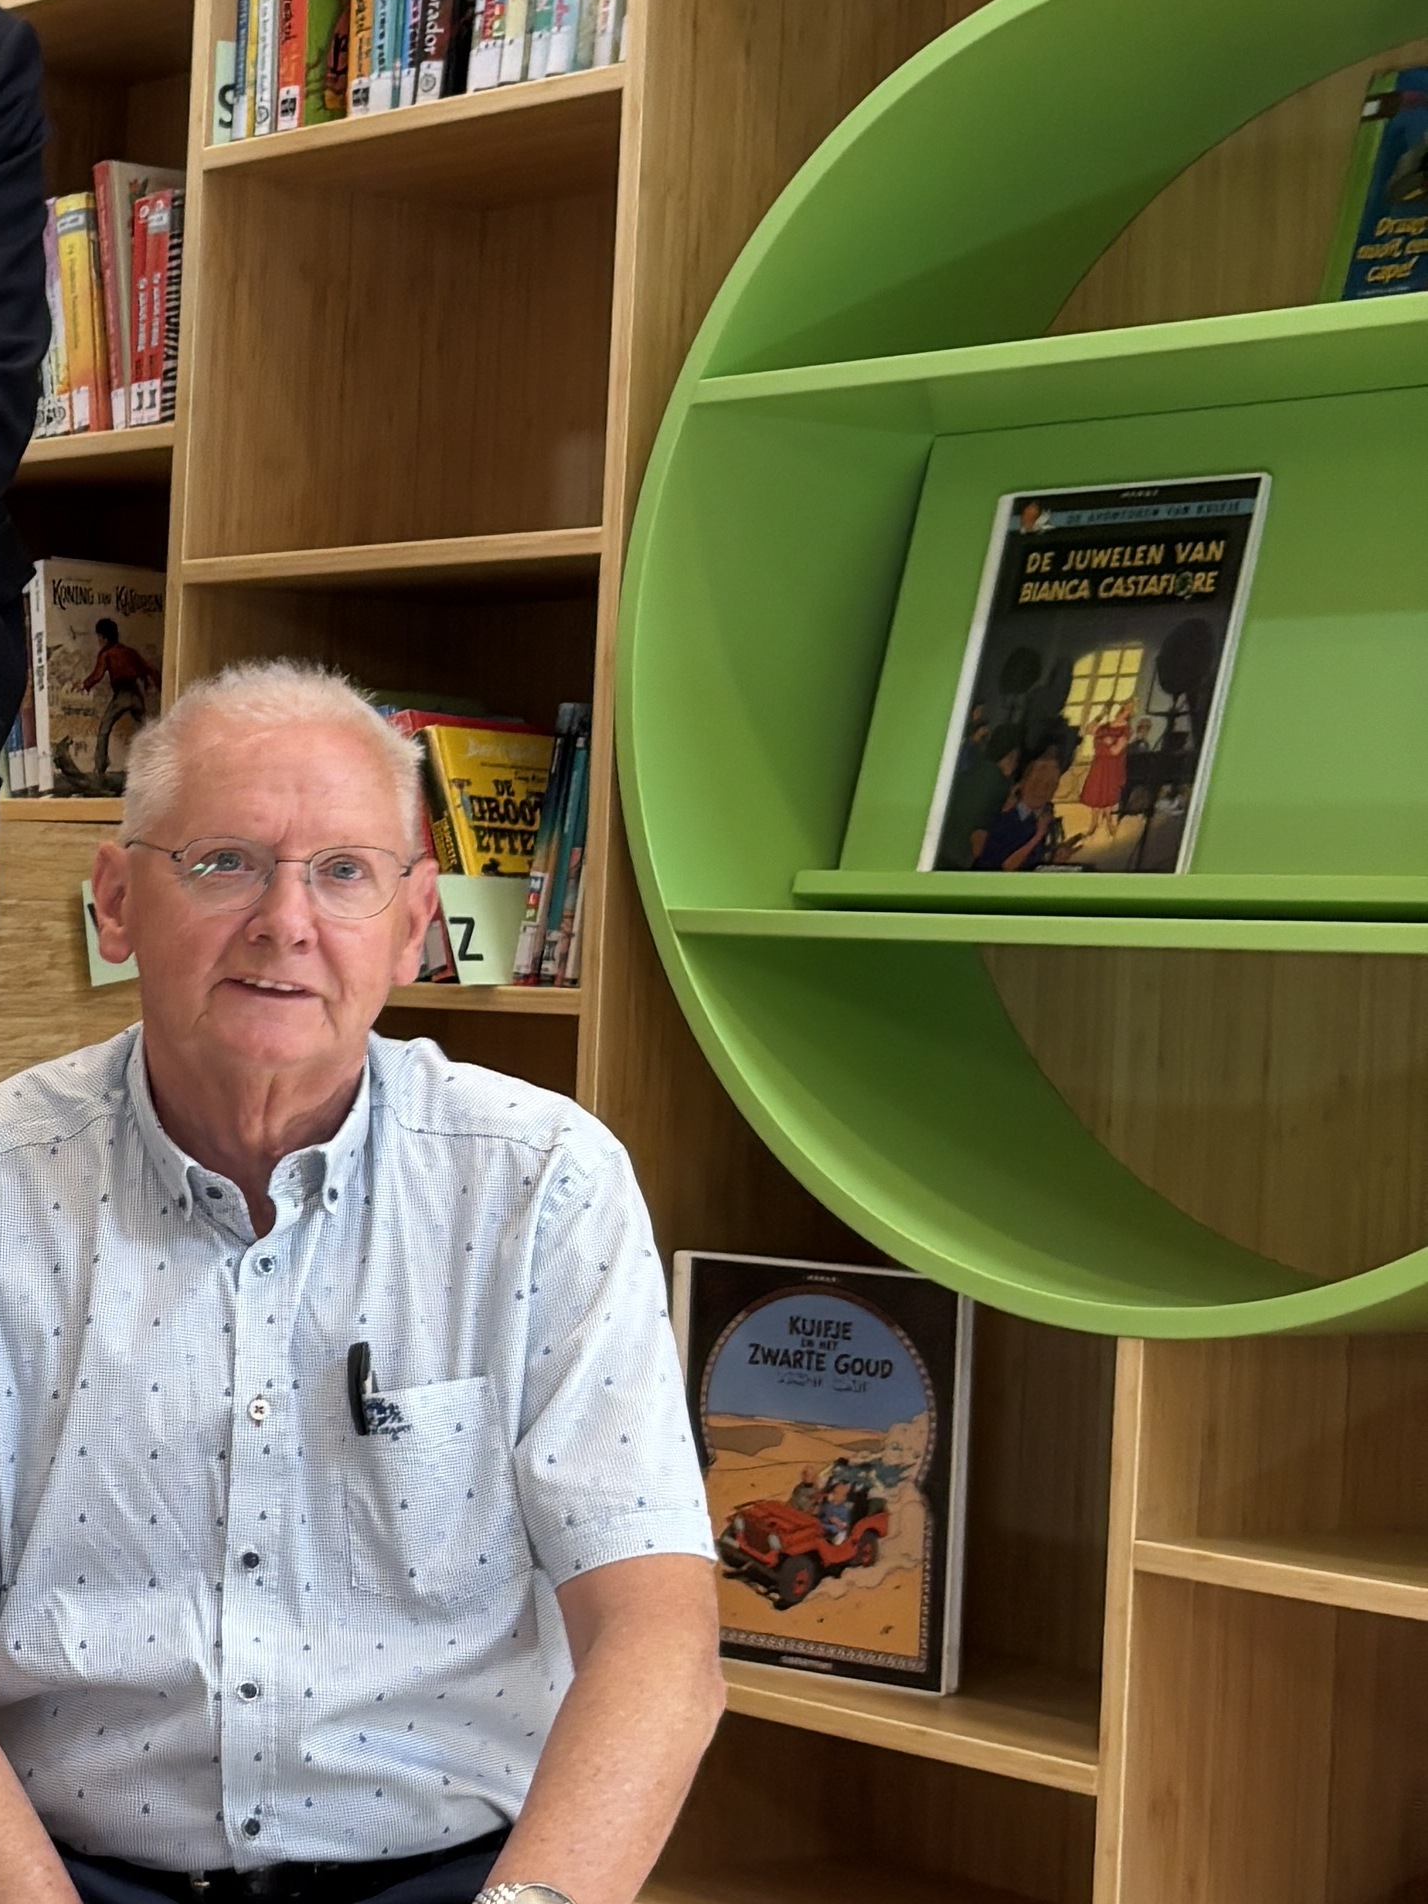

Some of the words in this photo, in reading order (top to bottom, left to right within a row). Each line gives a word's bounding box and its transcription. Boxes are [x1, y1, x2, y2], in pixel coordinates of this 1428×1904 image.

[218, 83, 235, 129] S
[1025, 550, 1056, 575] DE
[1061, 543, 1165, 572] JUWELEN
[1174, 540, 1227, 565] VAN
[1018, 578, 1092, 605] BIANCA
[1097, 571, 1220, 600] CASTAFIORE
[492, 779, 515, 797] DE
[472, 825, 537, 856] ETTE
[448, 916, 485, 962] Z
[788, 1315, 854, 1341] KUIFJE
[748, 1343, 827, 1372] ZWARTE
[834, 1353, 894, 1379] GOUD
